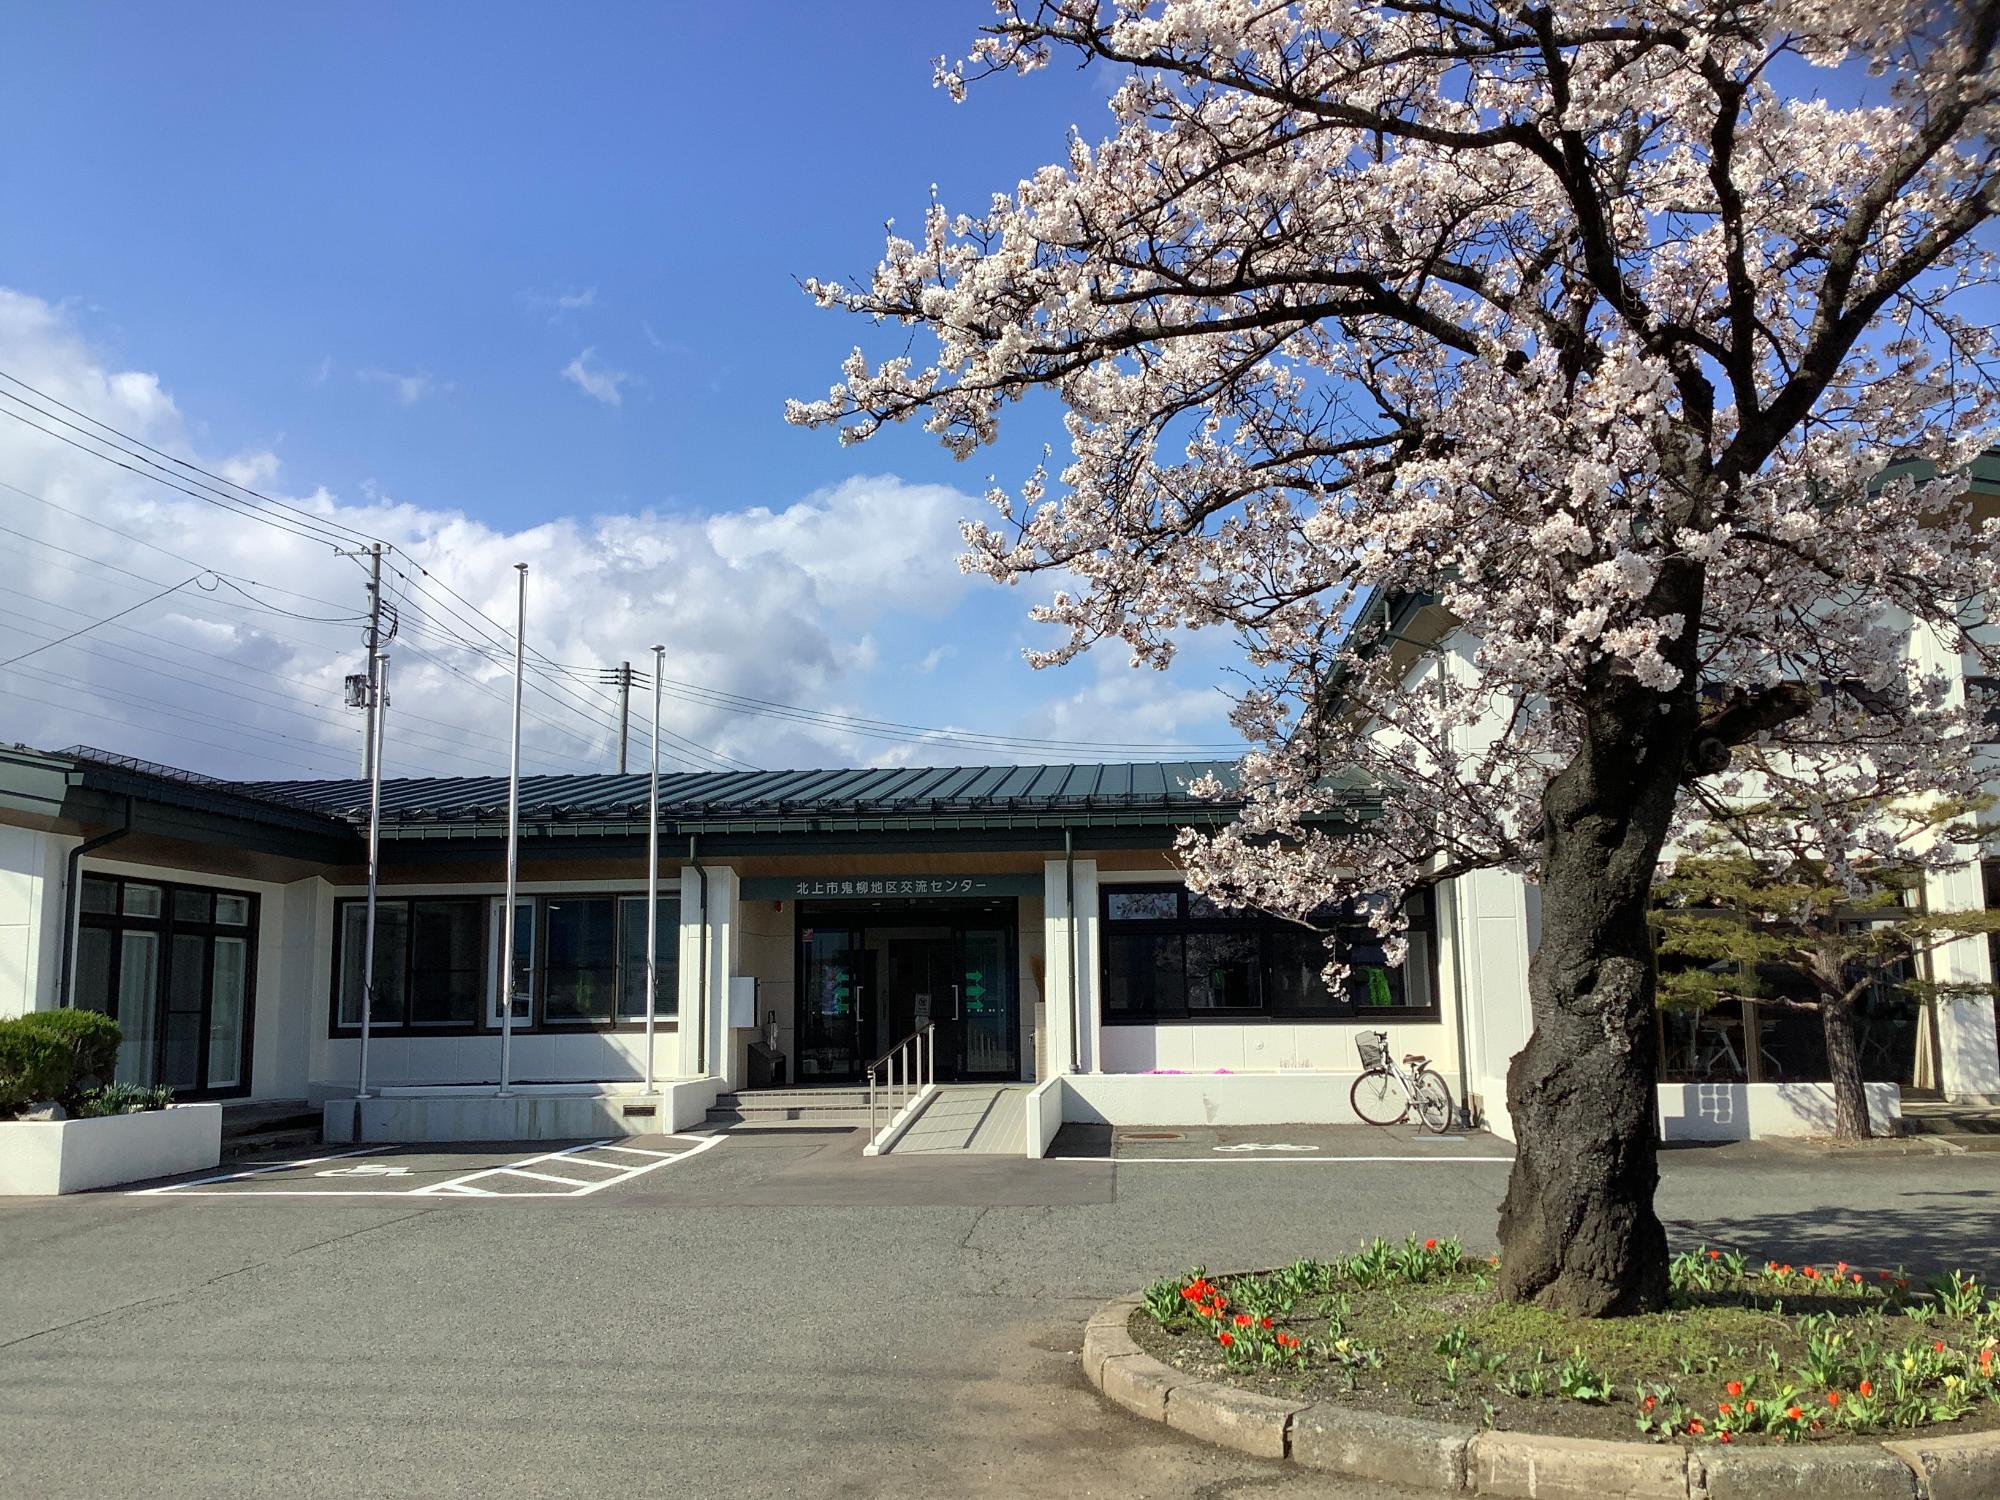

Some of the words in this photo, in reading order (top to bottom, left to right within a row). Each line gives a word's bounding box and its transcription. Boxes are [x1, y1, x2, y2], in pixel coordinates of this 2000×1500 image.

[796, 879, 987, 895] 北上市鬼柳地区交流センター
